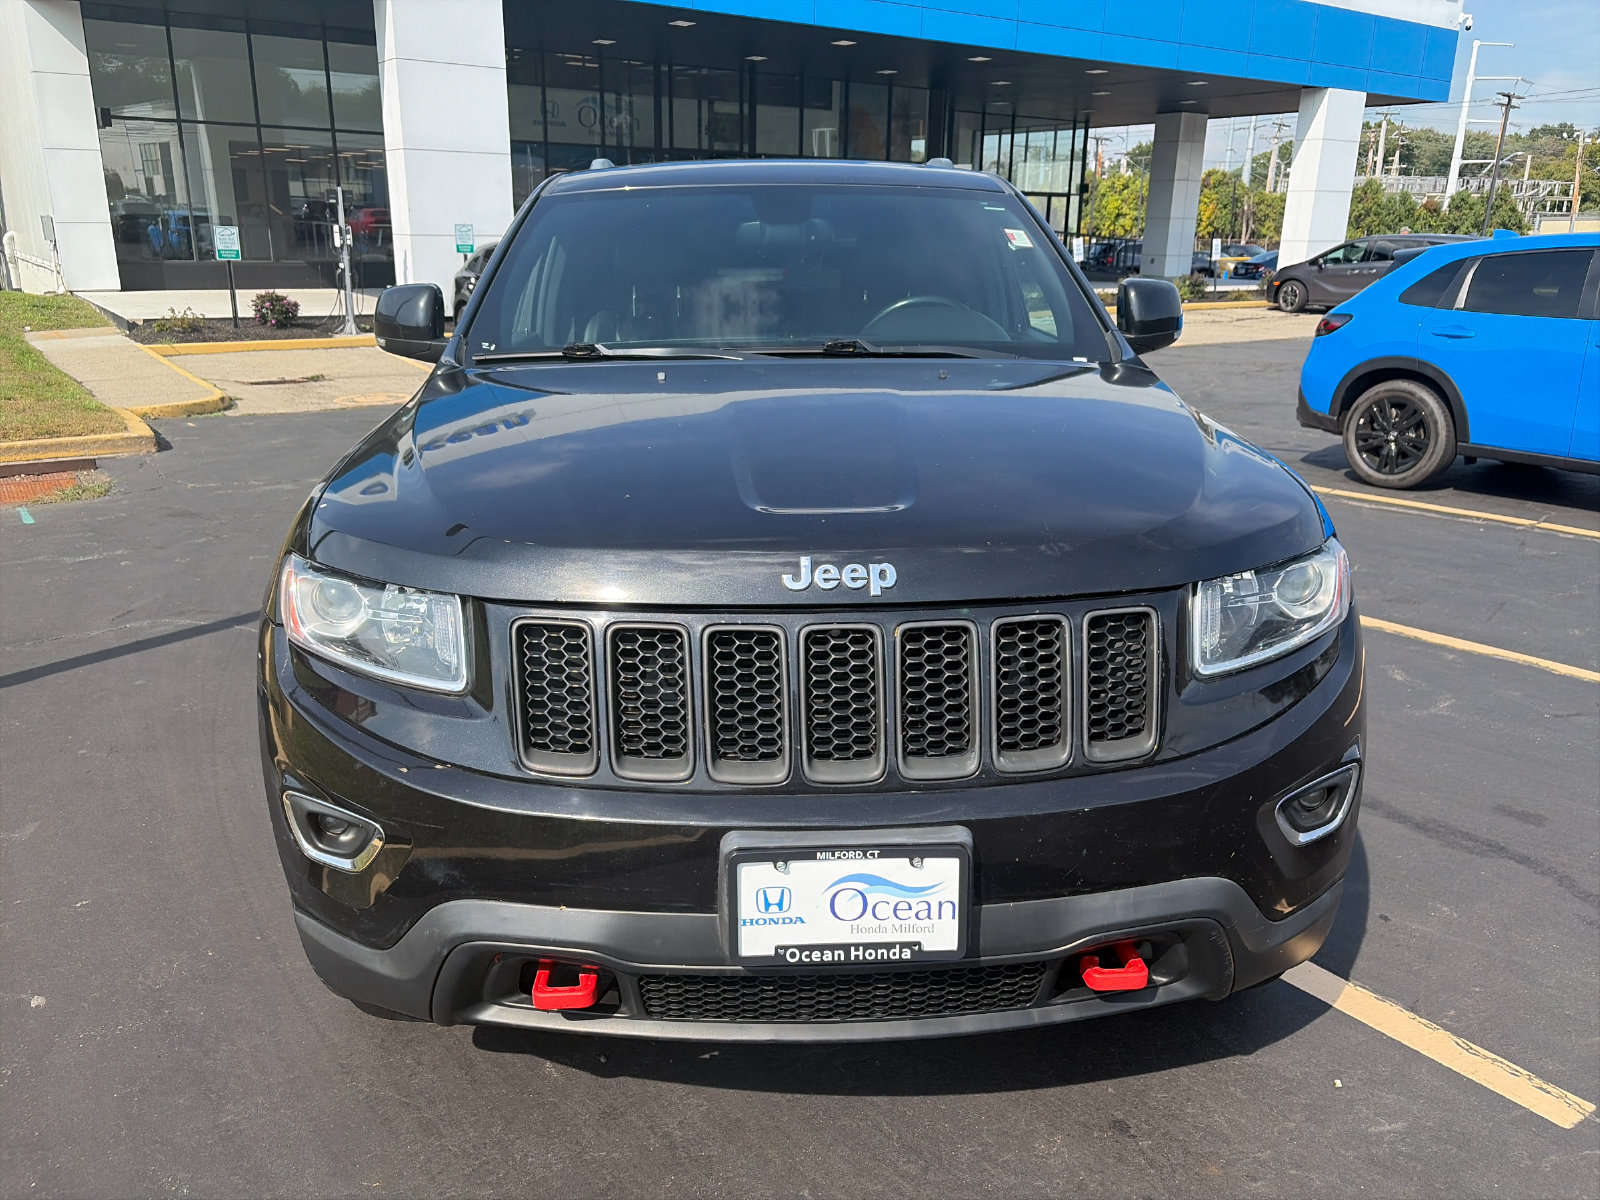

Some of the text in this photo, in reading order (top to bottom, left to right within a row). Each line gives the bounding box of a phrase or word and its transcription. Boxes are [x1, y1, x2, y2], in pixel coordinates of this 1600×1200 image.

[782, 556, 898, 597] Jeep
[865, 850, 880, 859] CT
[829, 888, 956, 921] Ocean
[741, 916, 806, 926] HONDA
[850, 922, 935, 934] Honda Milford
[785, 945, 911, 962] Ocean Honda
